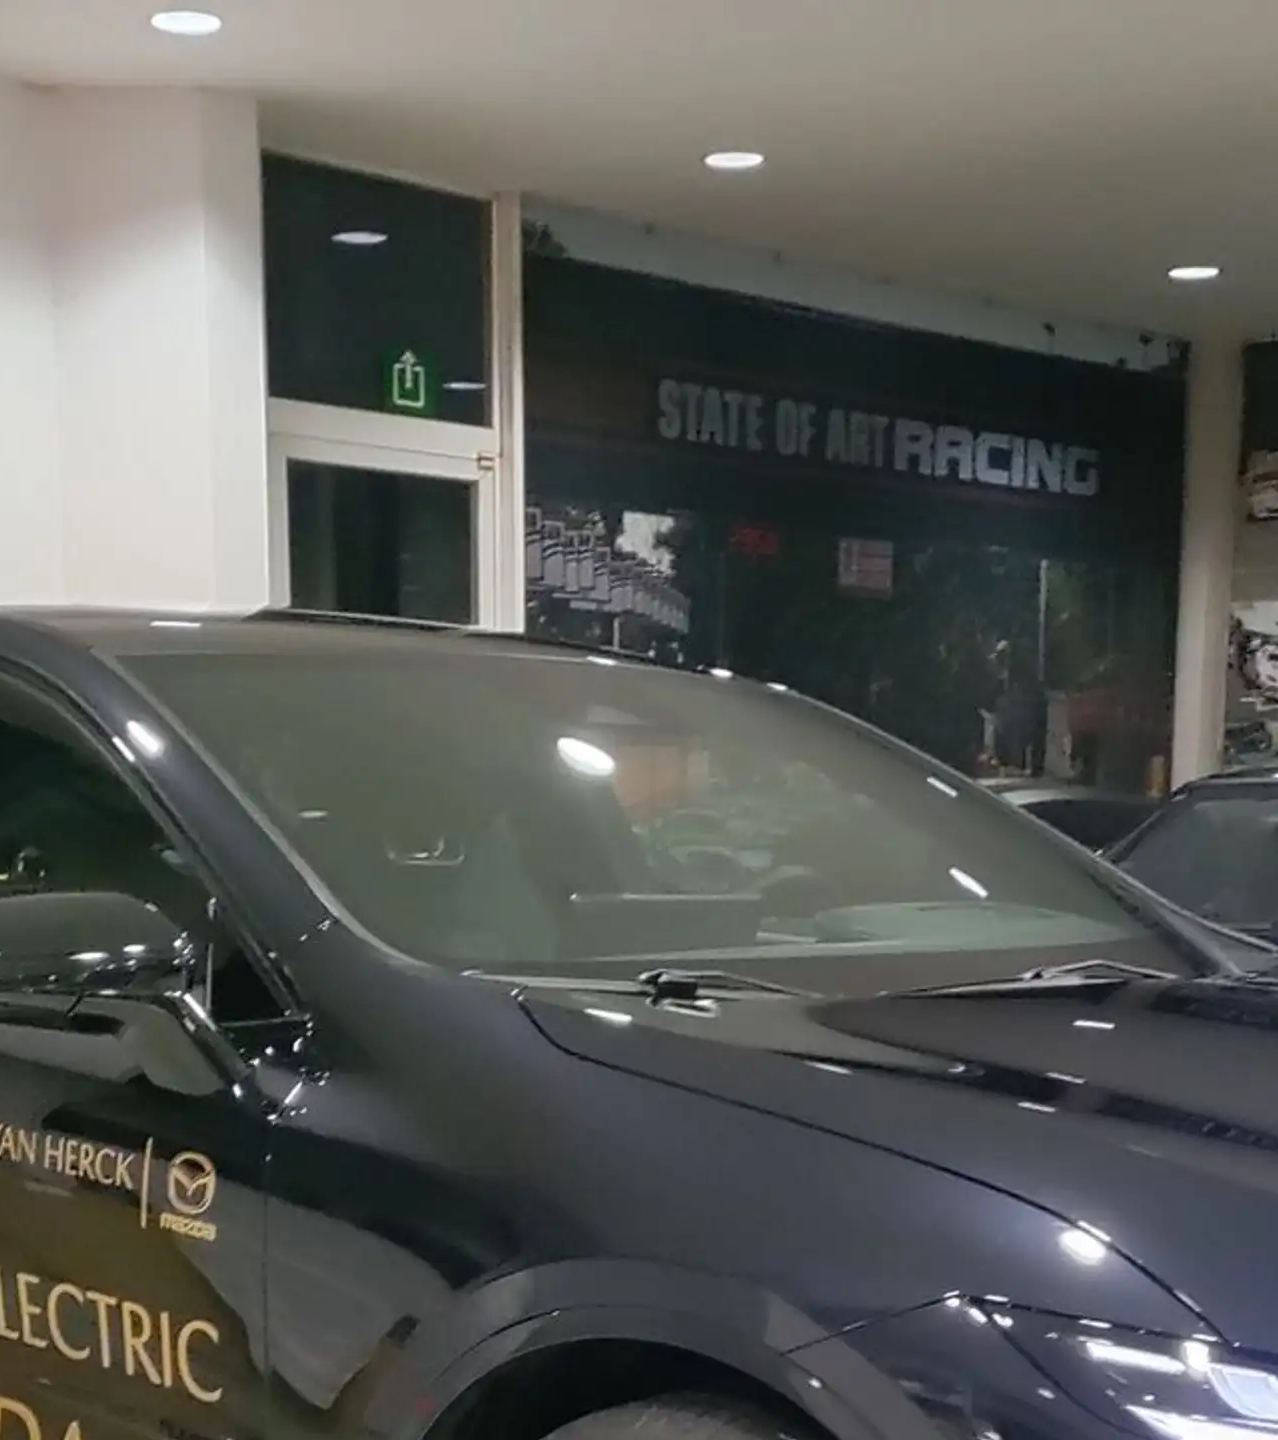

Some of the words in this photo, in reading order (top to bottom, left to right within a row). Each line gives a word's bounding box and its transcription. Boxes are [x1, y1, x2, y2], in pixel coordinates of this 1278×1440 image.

[657, 379, 763, 451] STATE
[775, 398, 817, 457] OF
[826, 408, 890, 469] ART
[893, 416, 1100, 497] RACING
[43, 1134, 134, 1190] HERCK
